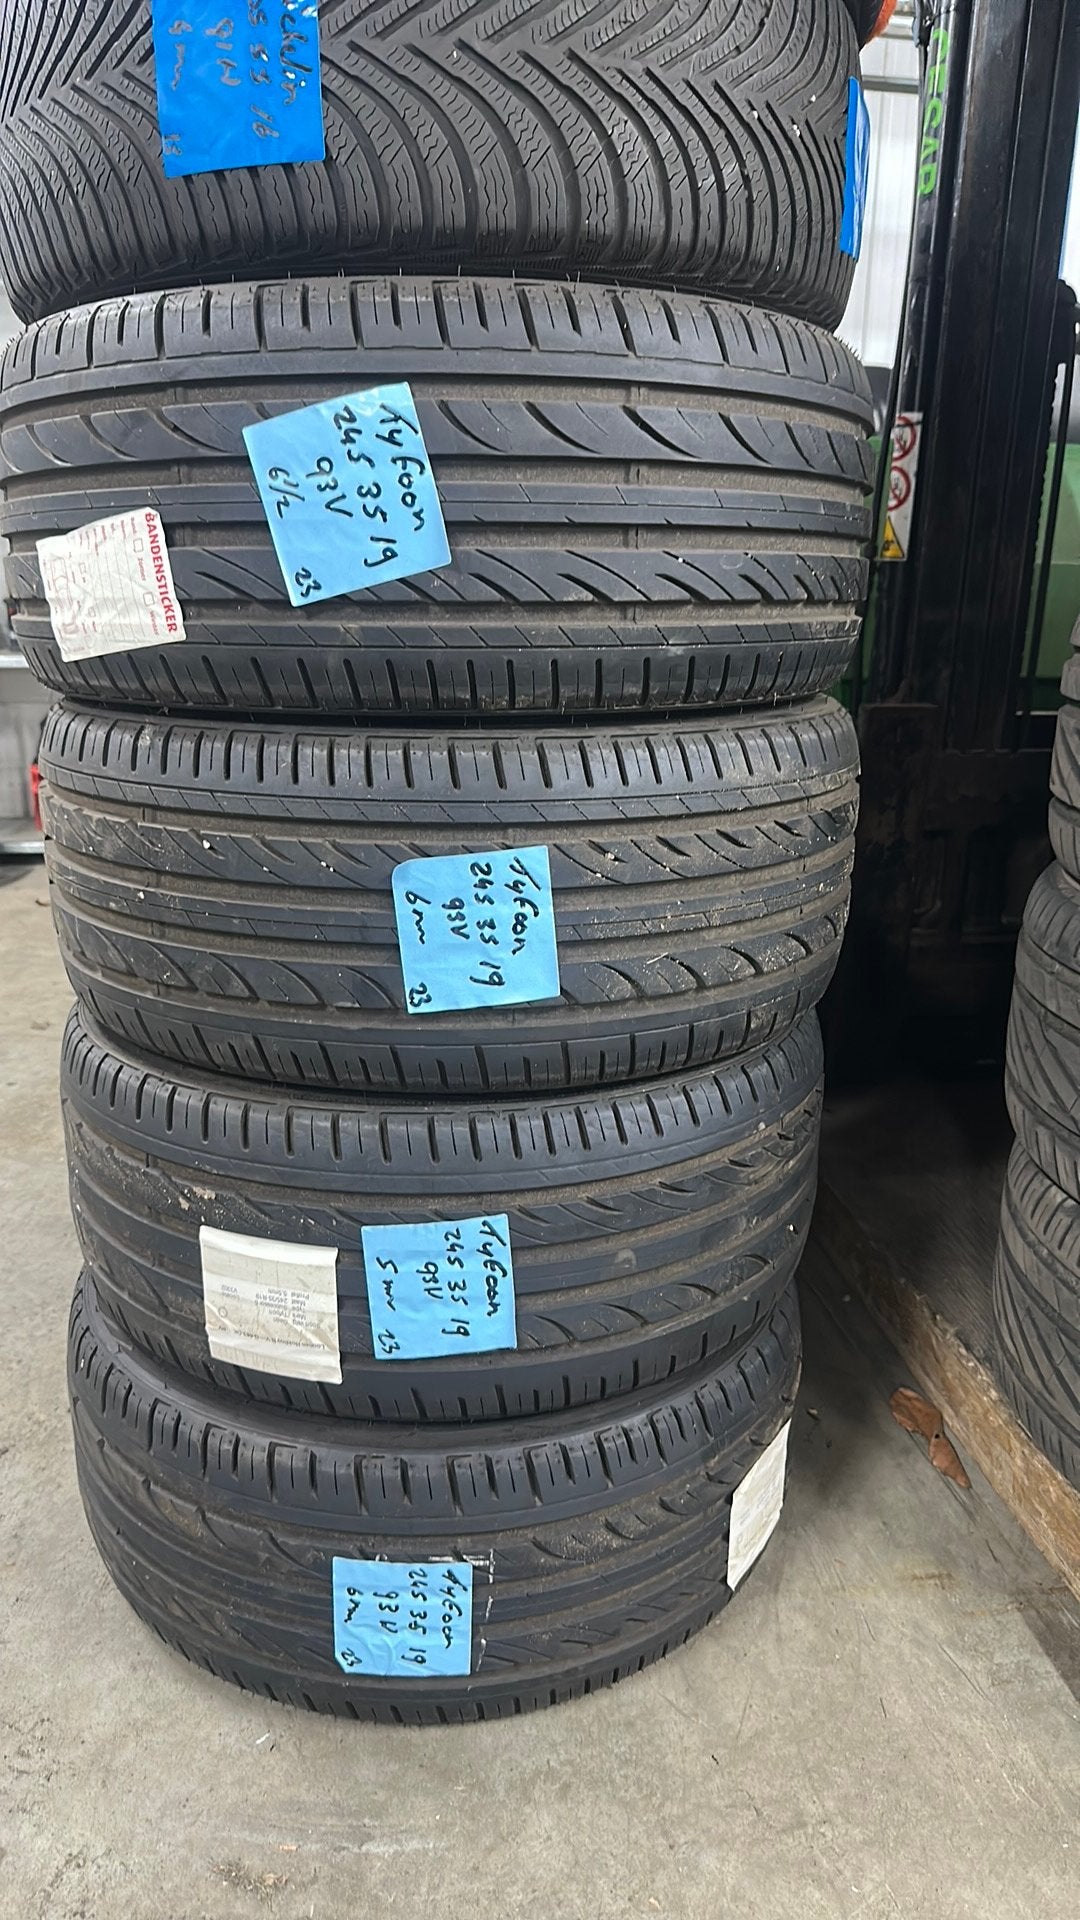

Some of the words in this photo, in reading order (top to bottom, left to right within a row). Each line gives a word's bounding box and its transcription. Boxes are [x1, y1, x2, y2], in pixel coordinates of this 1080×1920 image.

[251, 104, 280, 139] 16
[333, 405, 376, 468] 245
[305, 456, 354, 517] 93V
[357, 481, 388, 522] 35
[364, 535, 399, 568] 19
[145, 512, 178, 633] BANDENSTICKER
[294, 567, 322, 599] 23
[470, 862, 495, 906] 245
[441, 897, 471, 940] 93V
[475, 918, 500, 946] 35
[469, 961, 506, 986] 19
[408, 981, 433, 1008] 23
[444, 1227, 465, 1269] 245
[416, 1261, 443, 1299] 93V
[447, 1278, 469, 1306] 35
[378, 1328, 401, 1354] 23
[441, 1318, 471, 1337] 19
[408, 1567, 428, 1602] 245
[408, 1610, 428, 1635] 35
[340, 1648, 363, 1667] 23
[401, 1647, 427, 1665] 19
